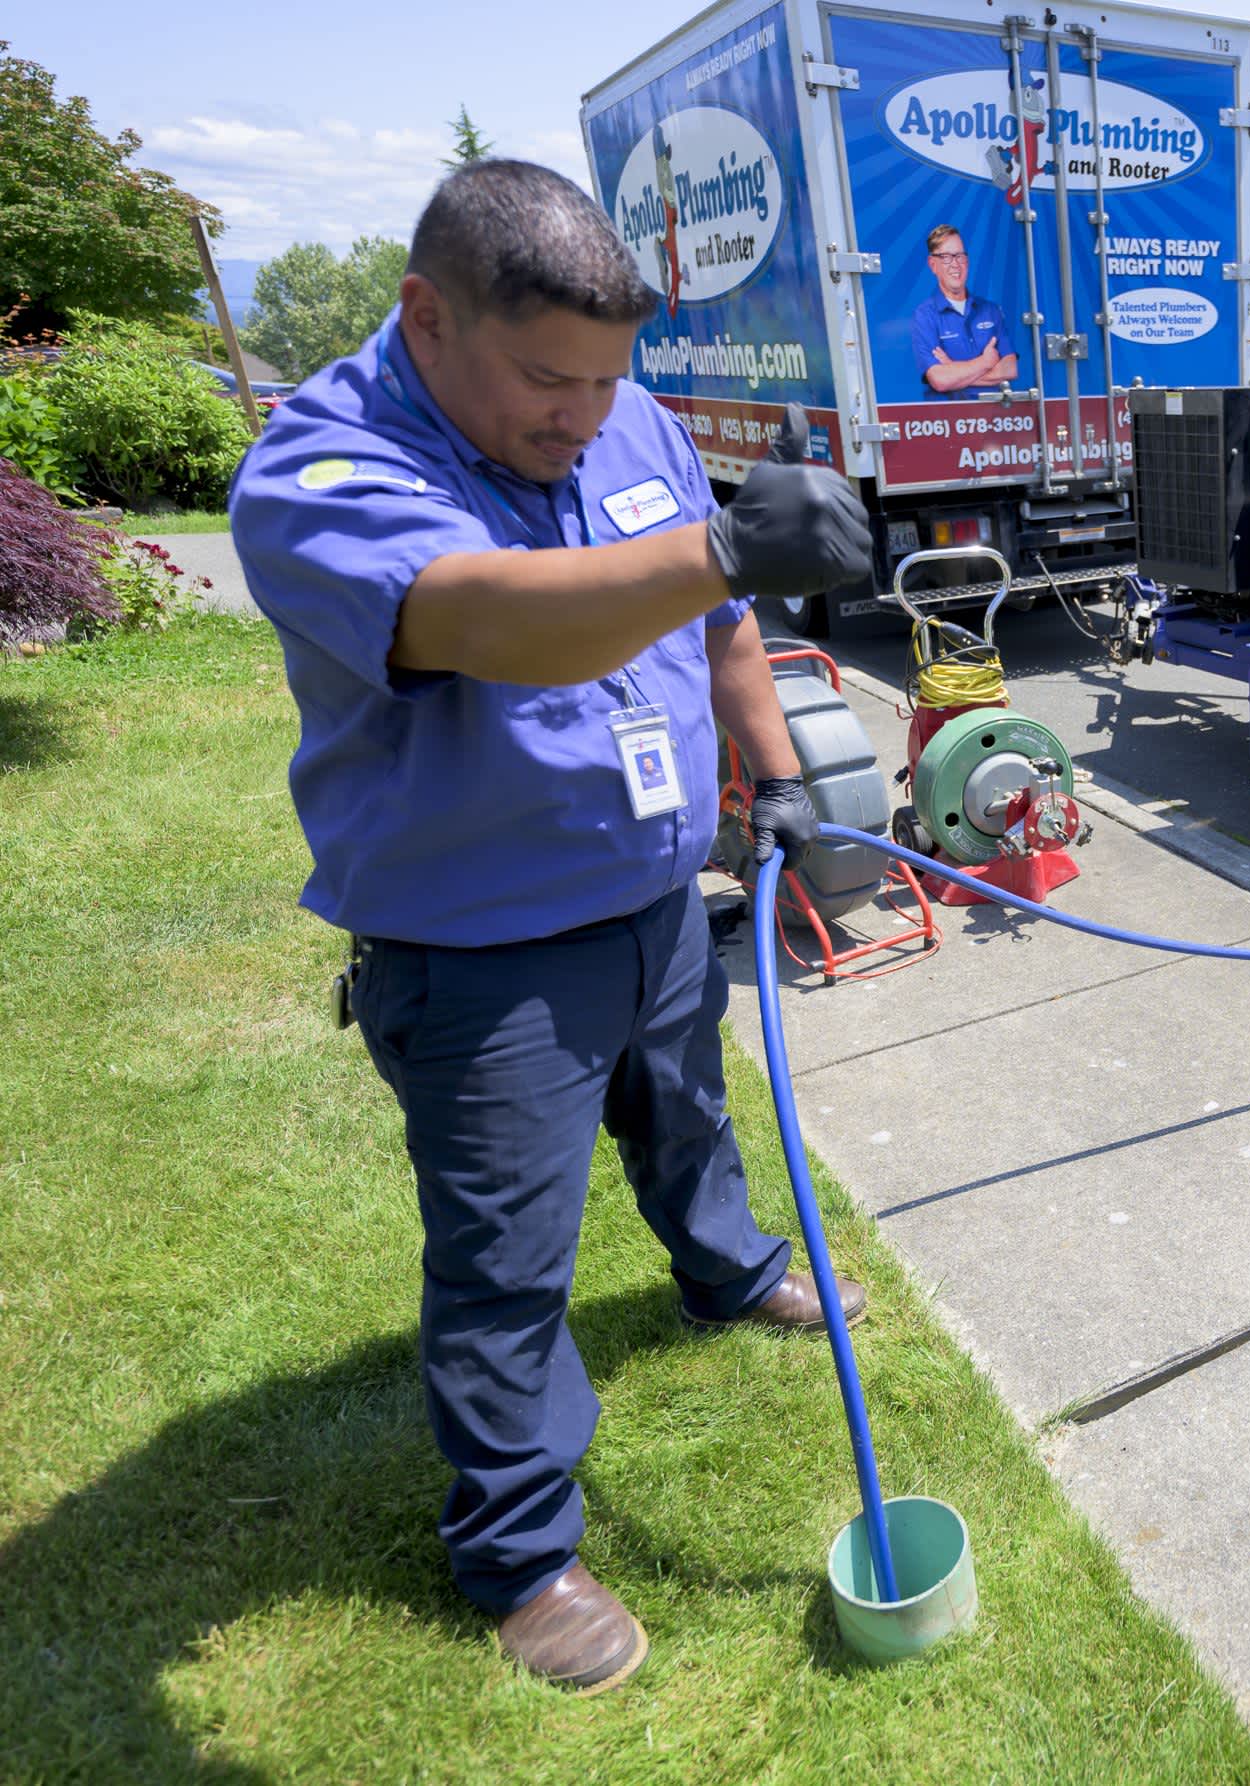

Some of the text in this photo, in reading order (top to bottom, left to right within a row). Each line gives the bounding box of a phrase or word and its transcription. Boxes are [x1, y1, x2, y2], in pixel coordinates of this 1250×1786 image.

[733, 34, 756, 65] RIGHT
[756, 22, 776, 52] NOW
[1212, 38, 1230, 52] 113
[899, 95, 1196, 163] Apollo Plumbing
[1108, 157, 1169, 181] Rooter
[621, 151, 769, 252] Apollo Plumbing
[696, 232, 756, 269] and Rooter
[1165, 240, 1220, 257] READY
[1108, 257, 1204, 277] RIGHT NOW
[1112, 302, 1207, 313] Talented Plumbers
[1118, 314, 1203, 326] Always Welcome
[1130, 327, 1194, 338] on Our Team
[640, 333, 808, 389] ApolloPlumbing.com
[719, 416, 744, 446] (425)
[904, 416, 1034, 440] (206) 678-3630
